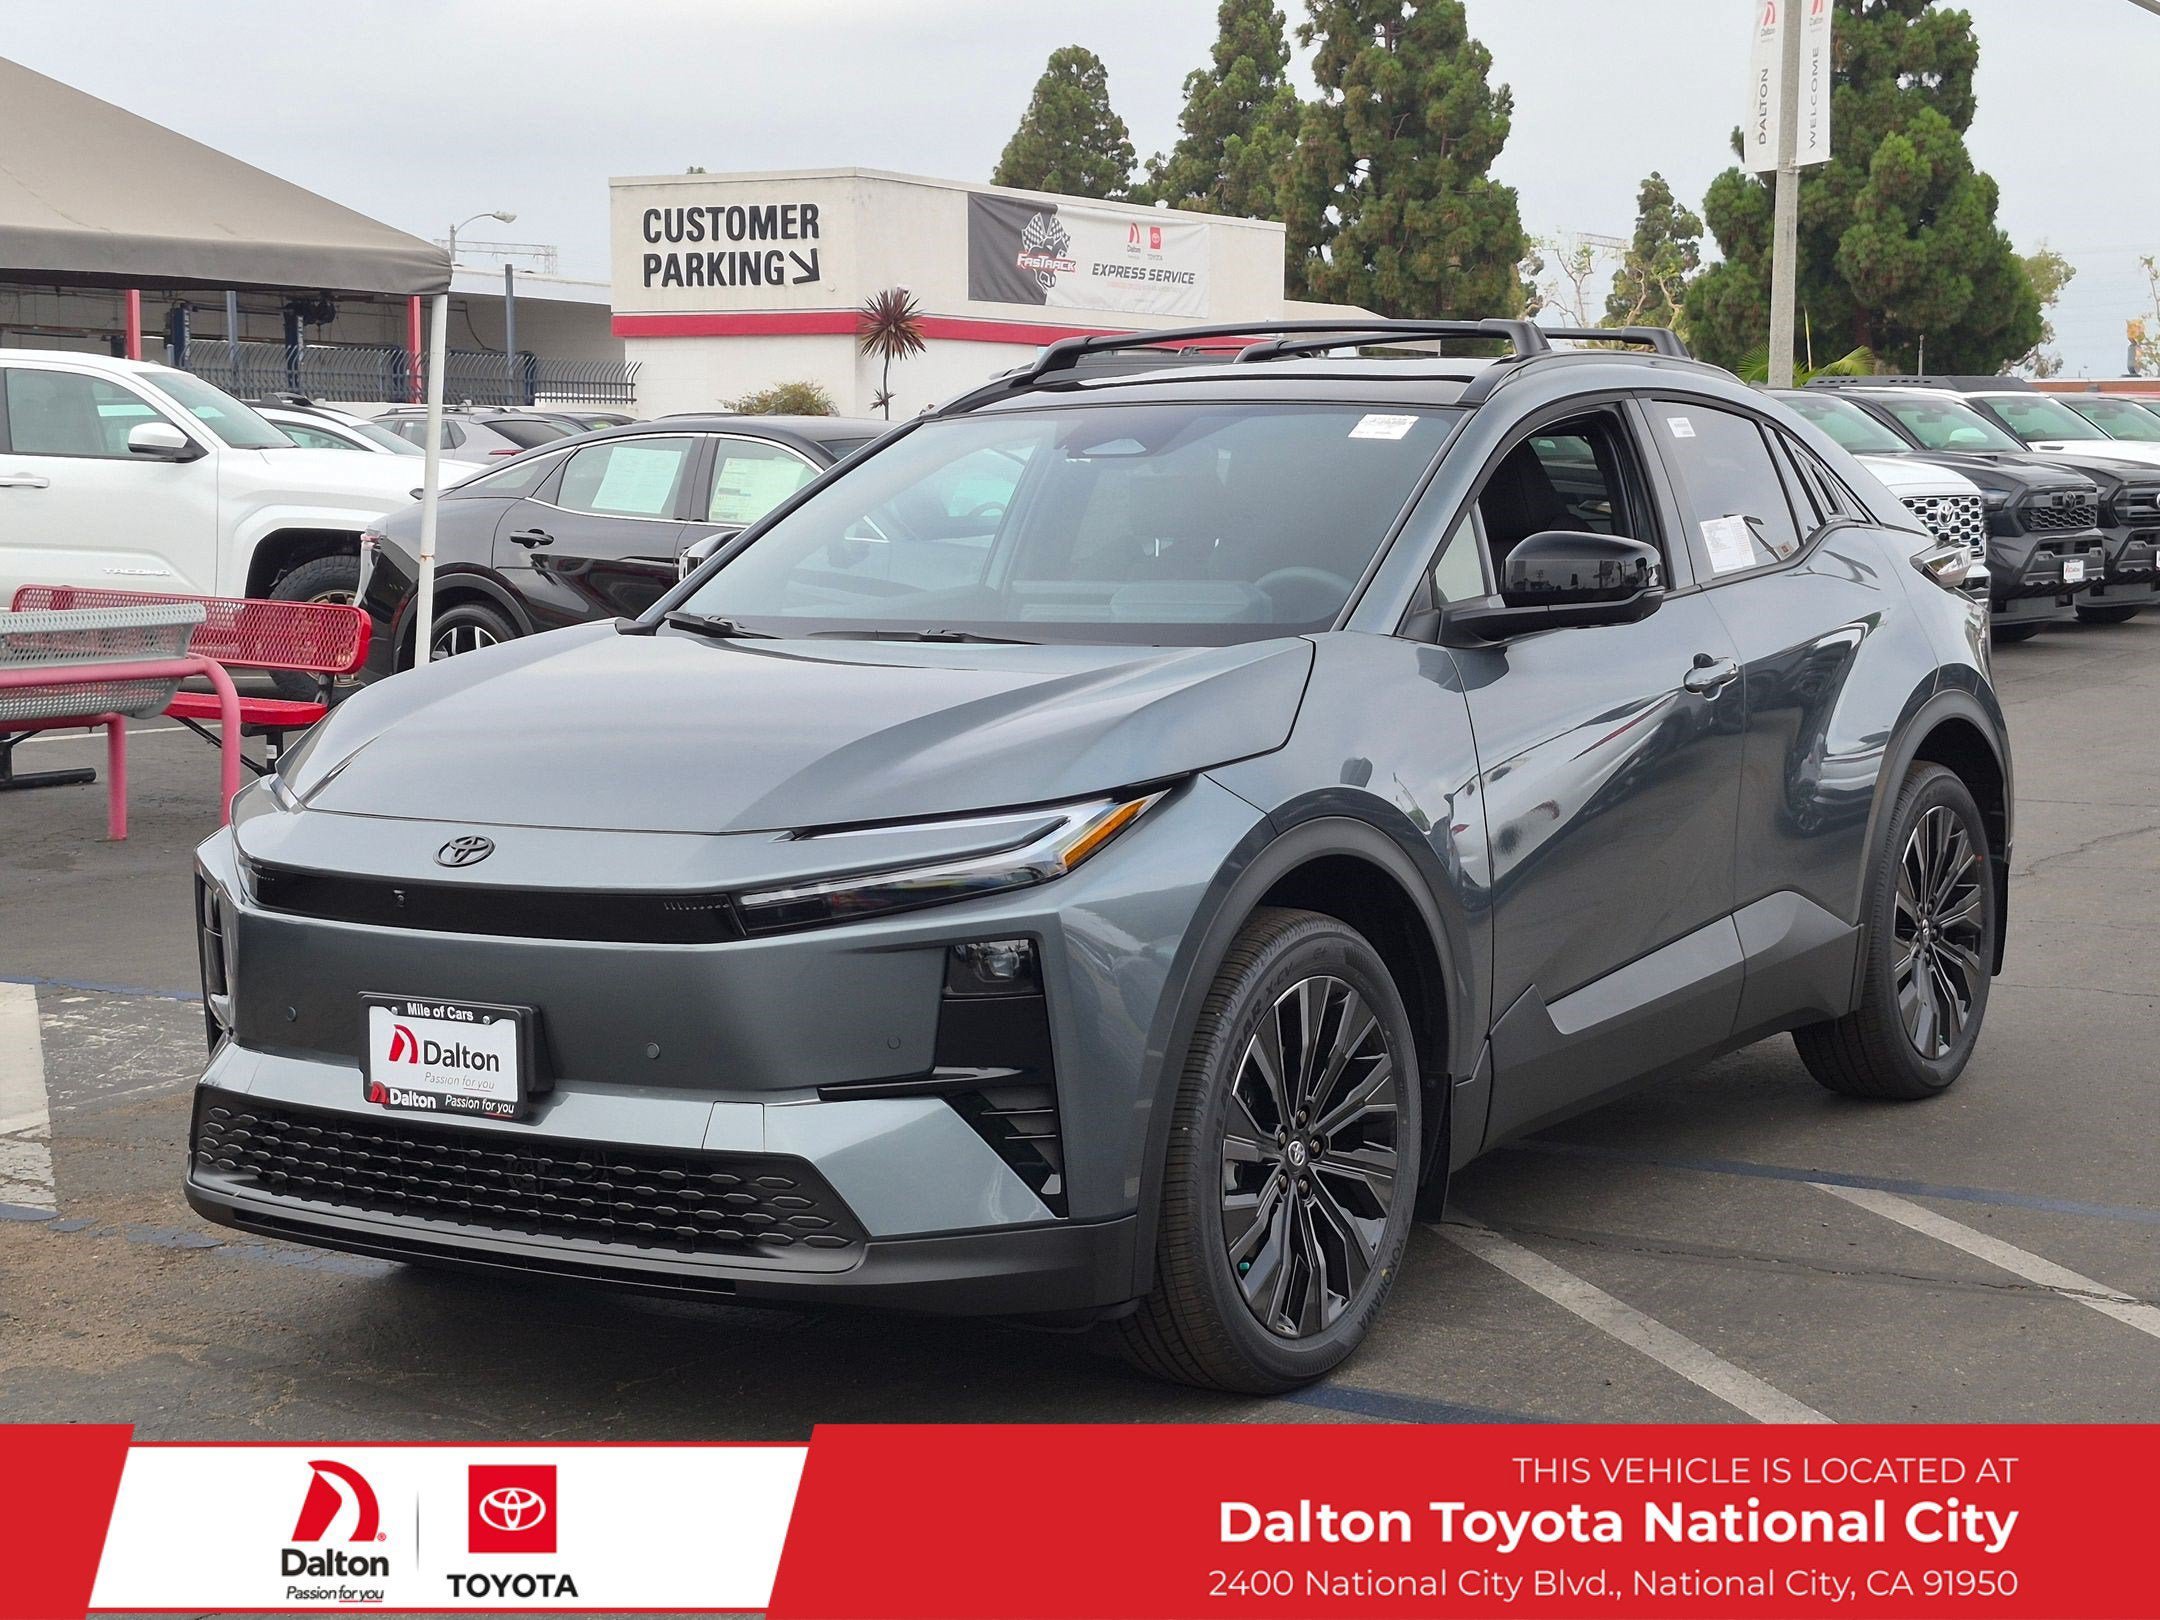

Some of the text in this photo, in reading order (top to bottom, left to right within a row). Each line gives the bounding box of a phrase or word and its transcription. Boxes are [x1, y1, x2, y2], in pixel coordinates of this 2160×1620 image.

[1759, 68, 1769, 145] DALTON
[1809, 47, 1820, 149] WELCOME
[643, 203, 820, 243] CUSTOMER
[643, 249, 785, 287] PARKING
[1092, 263, 1196, 285] EXPRESS SERVICE
[407, 1002, 474, 1022] Mile of Cars
[423, 1040, 500, 1072] Dalton
[424, 1071, 495, 1090] Passion for you
[390, 1088, 515, 1115] Dalton Passion for you
